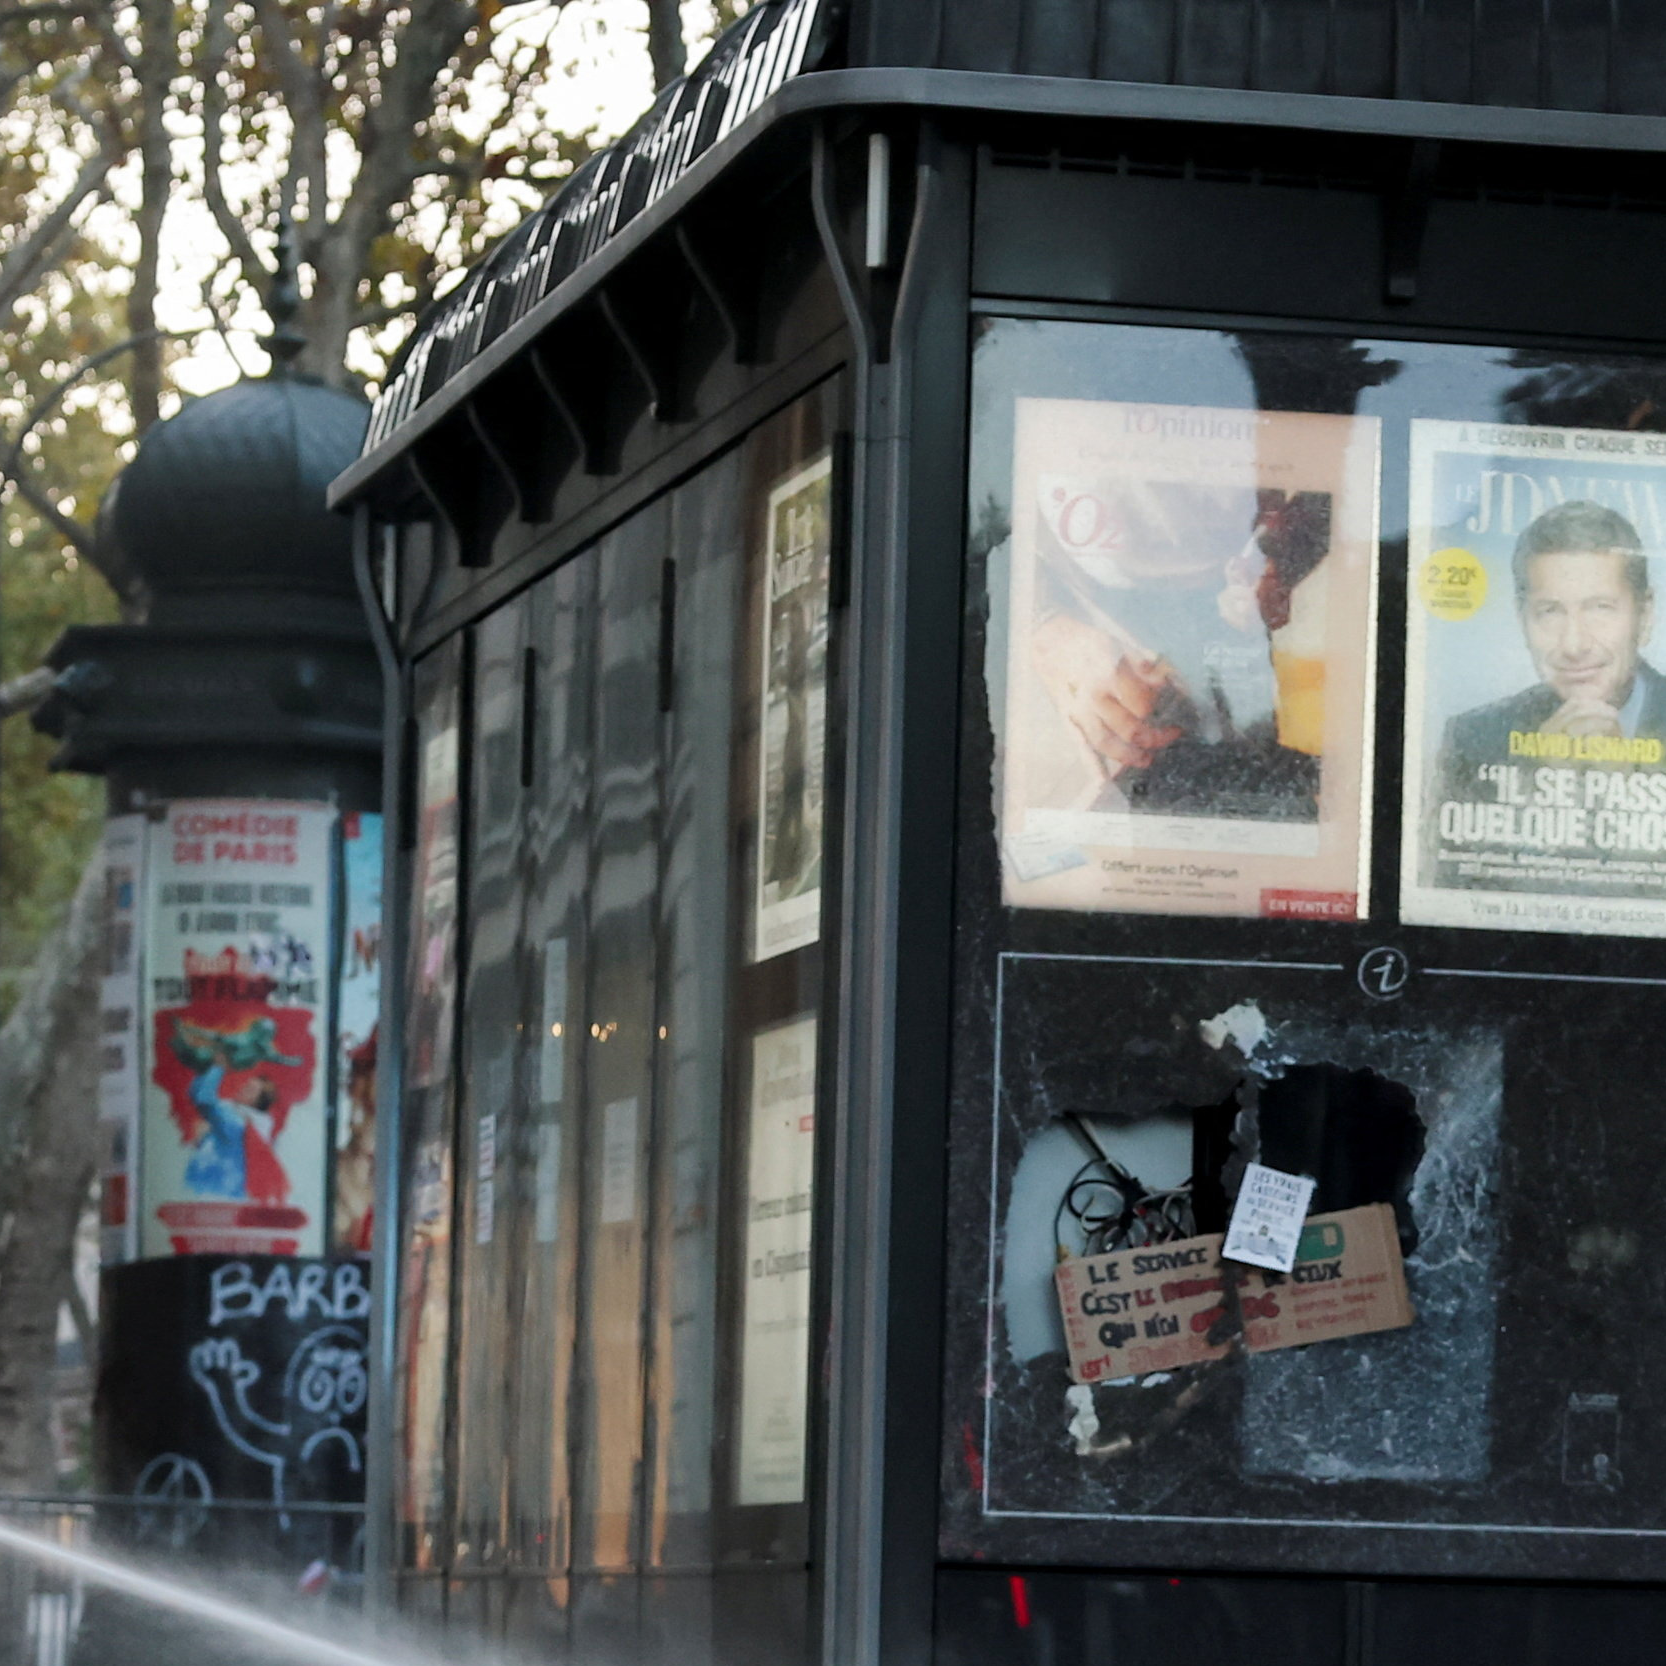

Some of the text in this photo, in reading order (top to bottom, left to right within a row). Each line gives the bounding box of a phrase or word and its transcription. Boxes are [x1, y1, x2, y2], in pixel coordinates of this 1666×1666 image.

[1509, 730, 1570, 759] DAVID
[1534, 766, 1576, 808] SE
[1438, 800, 1589, 850] QUELQUE
[171, 842, 299, 866] DE PARIS
[1289, 900, 1330, 914] VENTE
[1088, 1247, 1208, 1285] LE SERVICE
